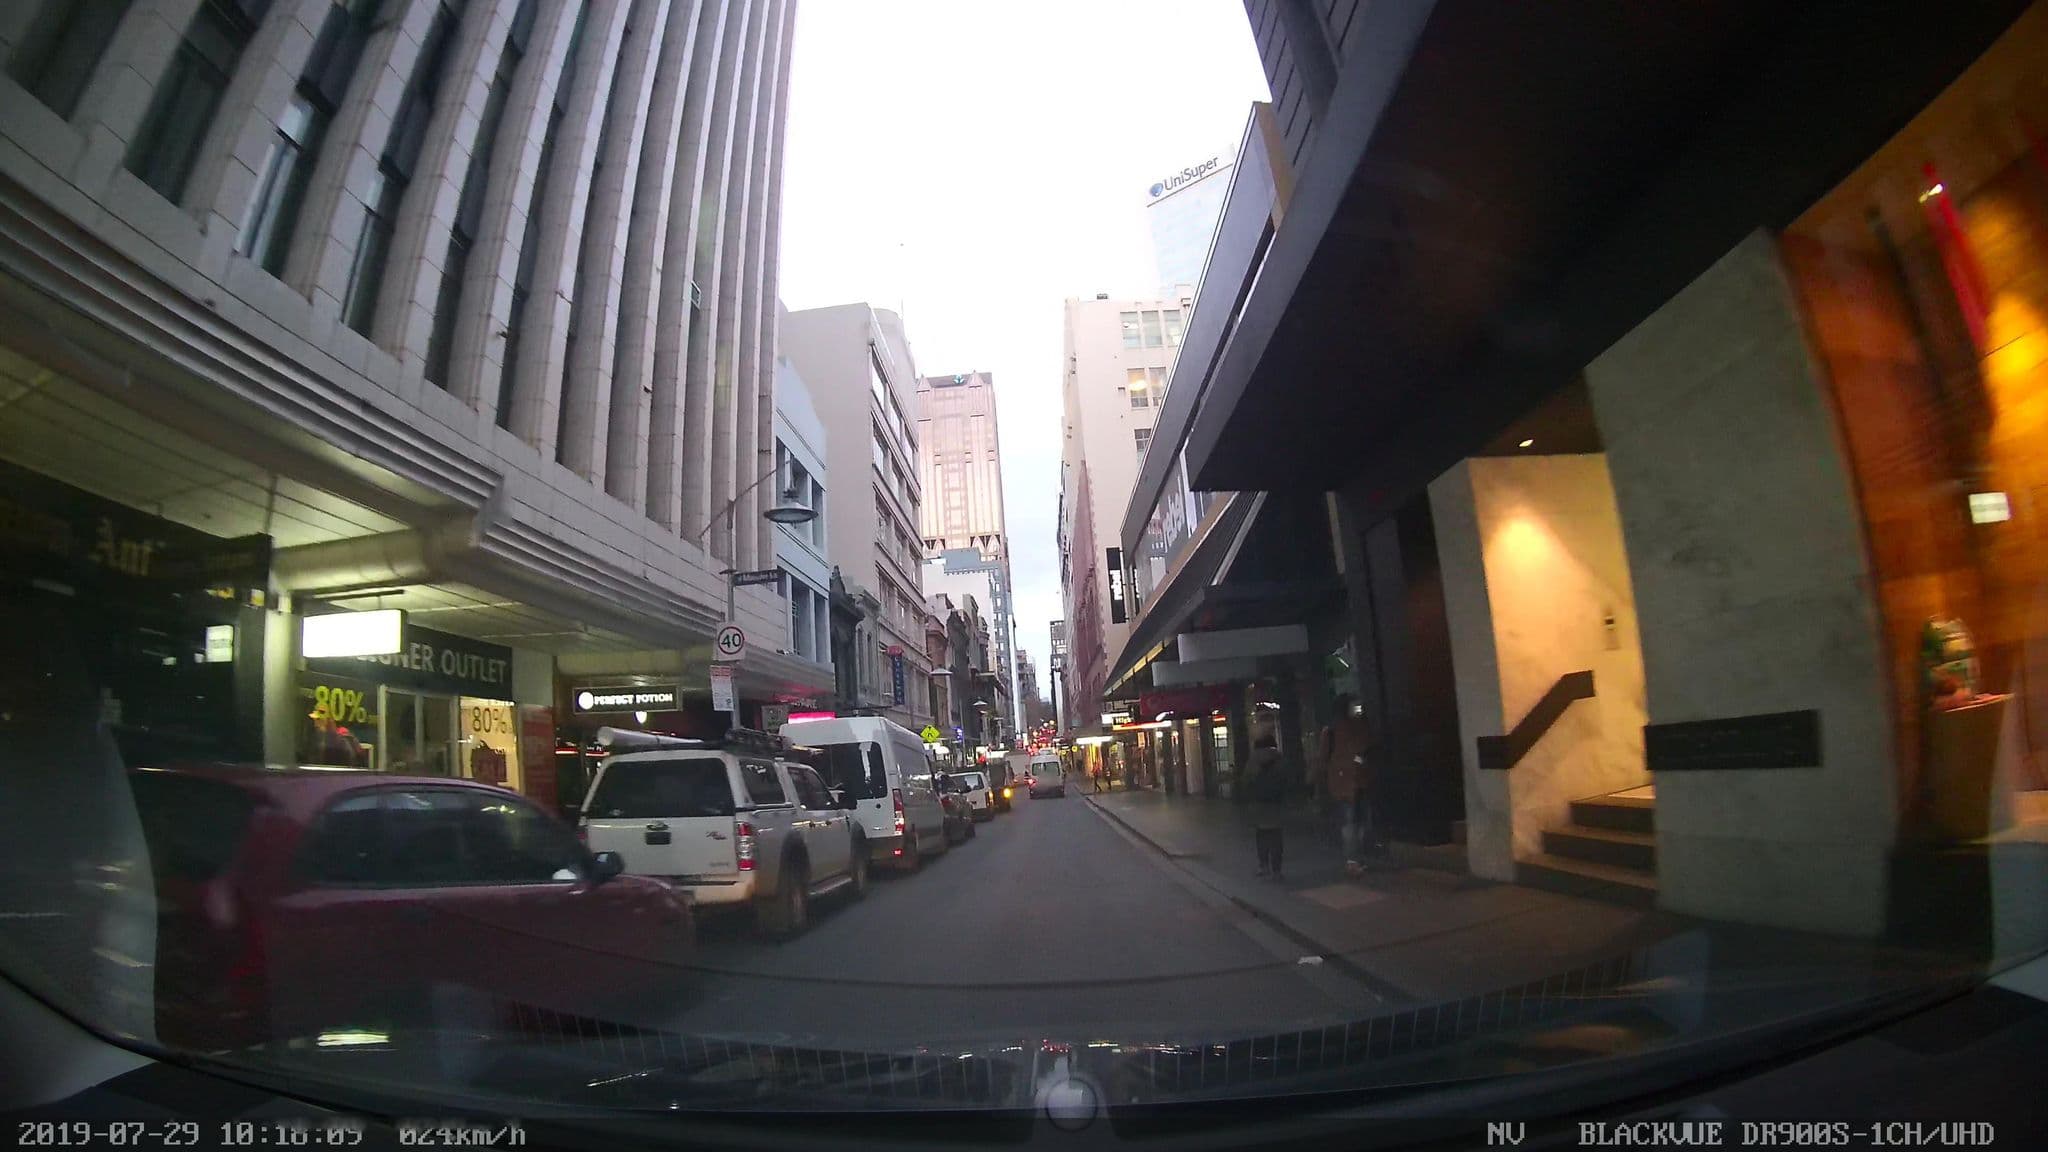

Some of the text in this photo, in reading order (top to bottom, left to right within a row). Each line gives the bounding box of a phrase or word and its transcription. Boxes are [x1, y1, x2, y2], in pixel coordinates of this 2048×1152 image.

[1163, 156, 1219, 191] UniSuper
[720, 633, 742, 649] 40
[441, 650, 507, 683] OUTLET
[314, 685, 368, 723] 80%
[594, 693, 673, 705] PERFECT POTION
[472, 706, 508, 734] 80%
